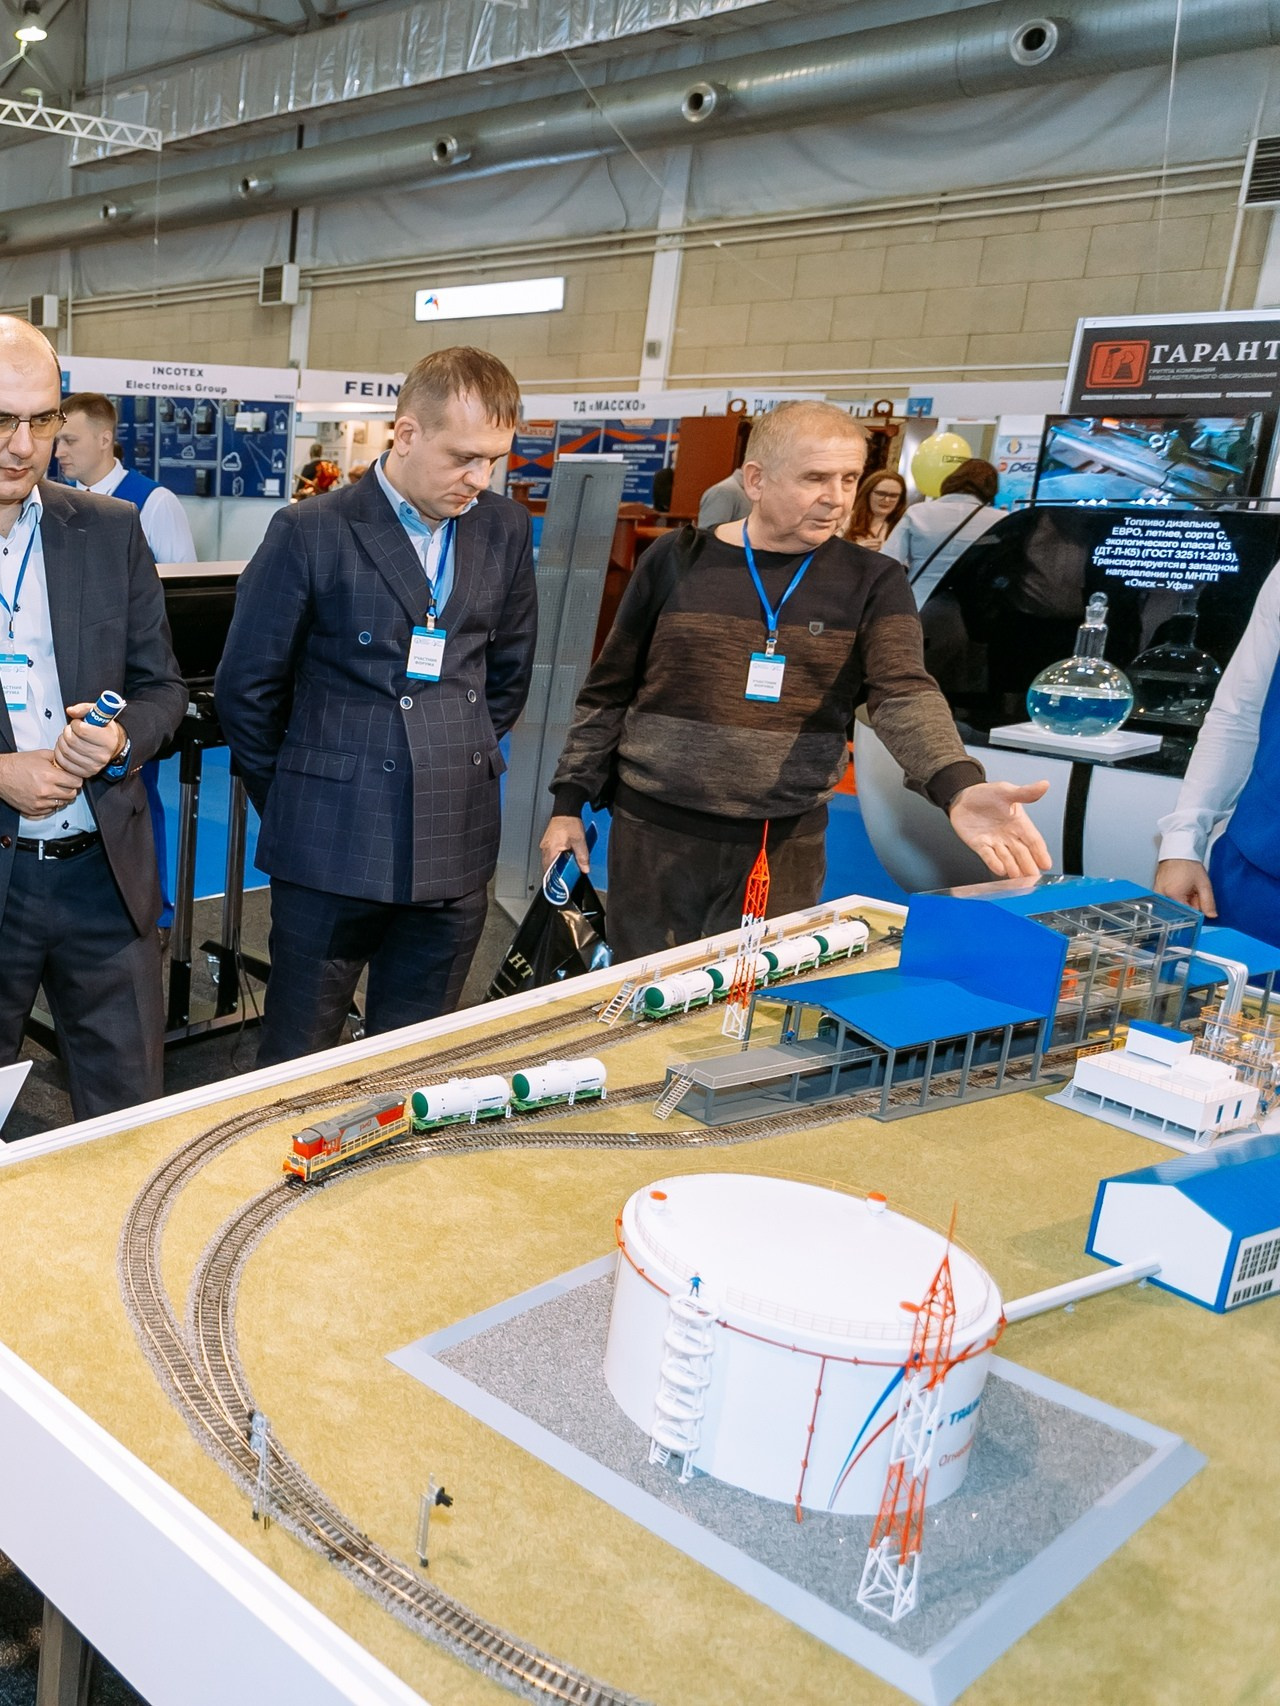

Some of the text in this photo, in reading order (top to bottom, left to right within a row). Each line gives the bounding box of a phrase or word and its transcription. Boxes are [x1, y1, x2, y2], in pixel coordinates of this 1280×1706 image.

[1150, 340, 1280, 364] ГАРАНТ
[152, 366, 204, 377] INCOTEX
[126, 380, 228, 394] Electronics Group
[573, 400, 586, 412] ТД
[1124, 517, 1221, 530] Топливо дизельное
[1112, 527, 1143, 537] ЕВРО,
[1145, 530, 1183, 539] летнее,
[1185, 532, 1213, 541] сорта
[1106, 538, 1231, 550] экологического класса К5
[1095, 546, 1239, 562] (ДТ-Л-К5) (ГОСТ 32511-2013).
[1092, 556, 1180, 569] Транспортируется
[1188, 563, 1239, 573] западном
[1106, 568, 1169, 580] направлении
[1185, 572, 1219, 581] МНПП
[1125, 579, 1156, 588] «Омск
[1166, 581, 1194, 591] Уфа»
